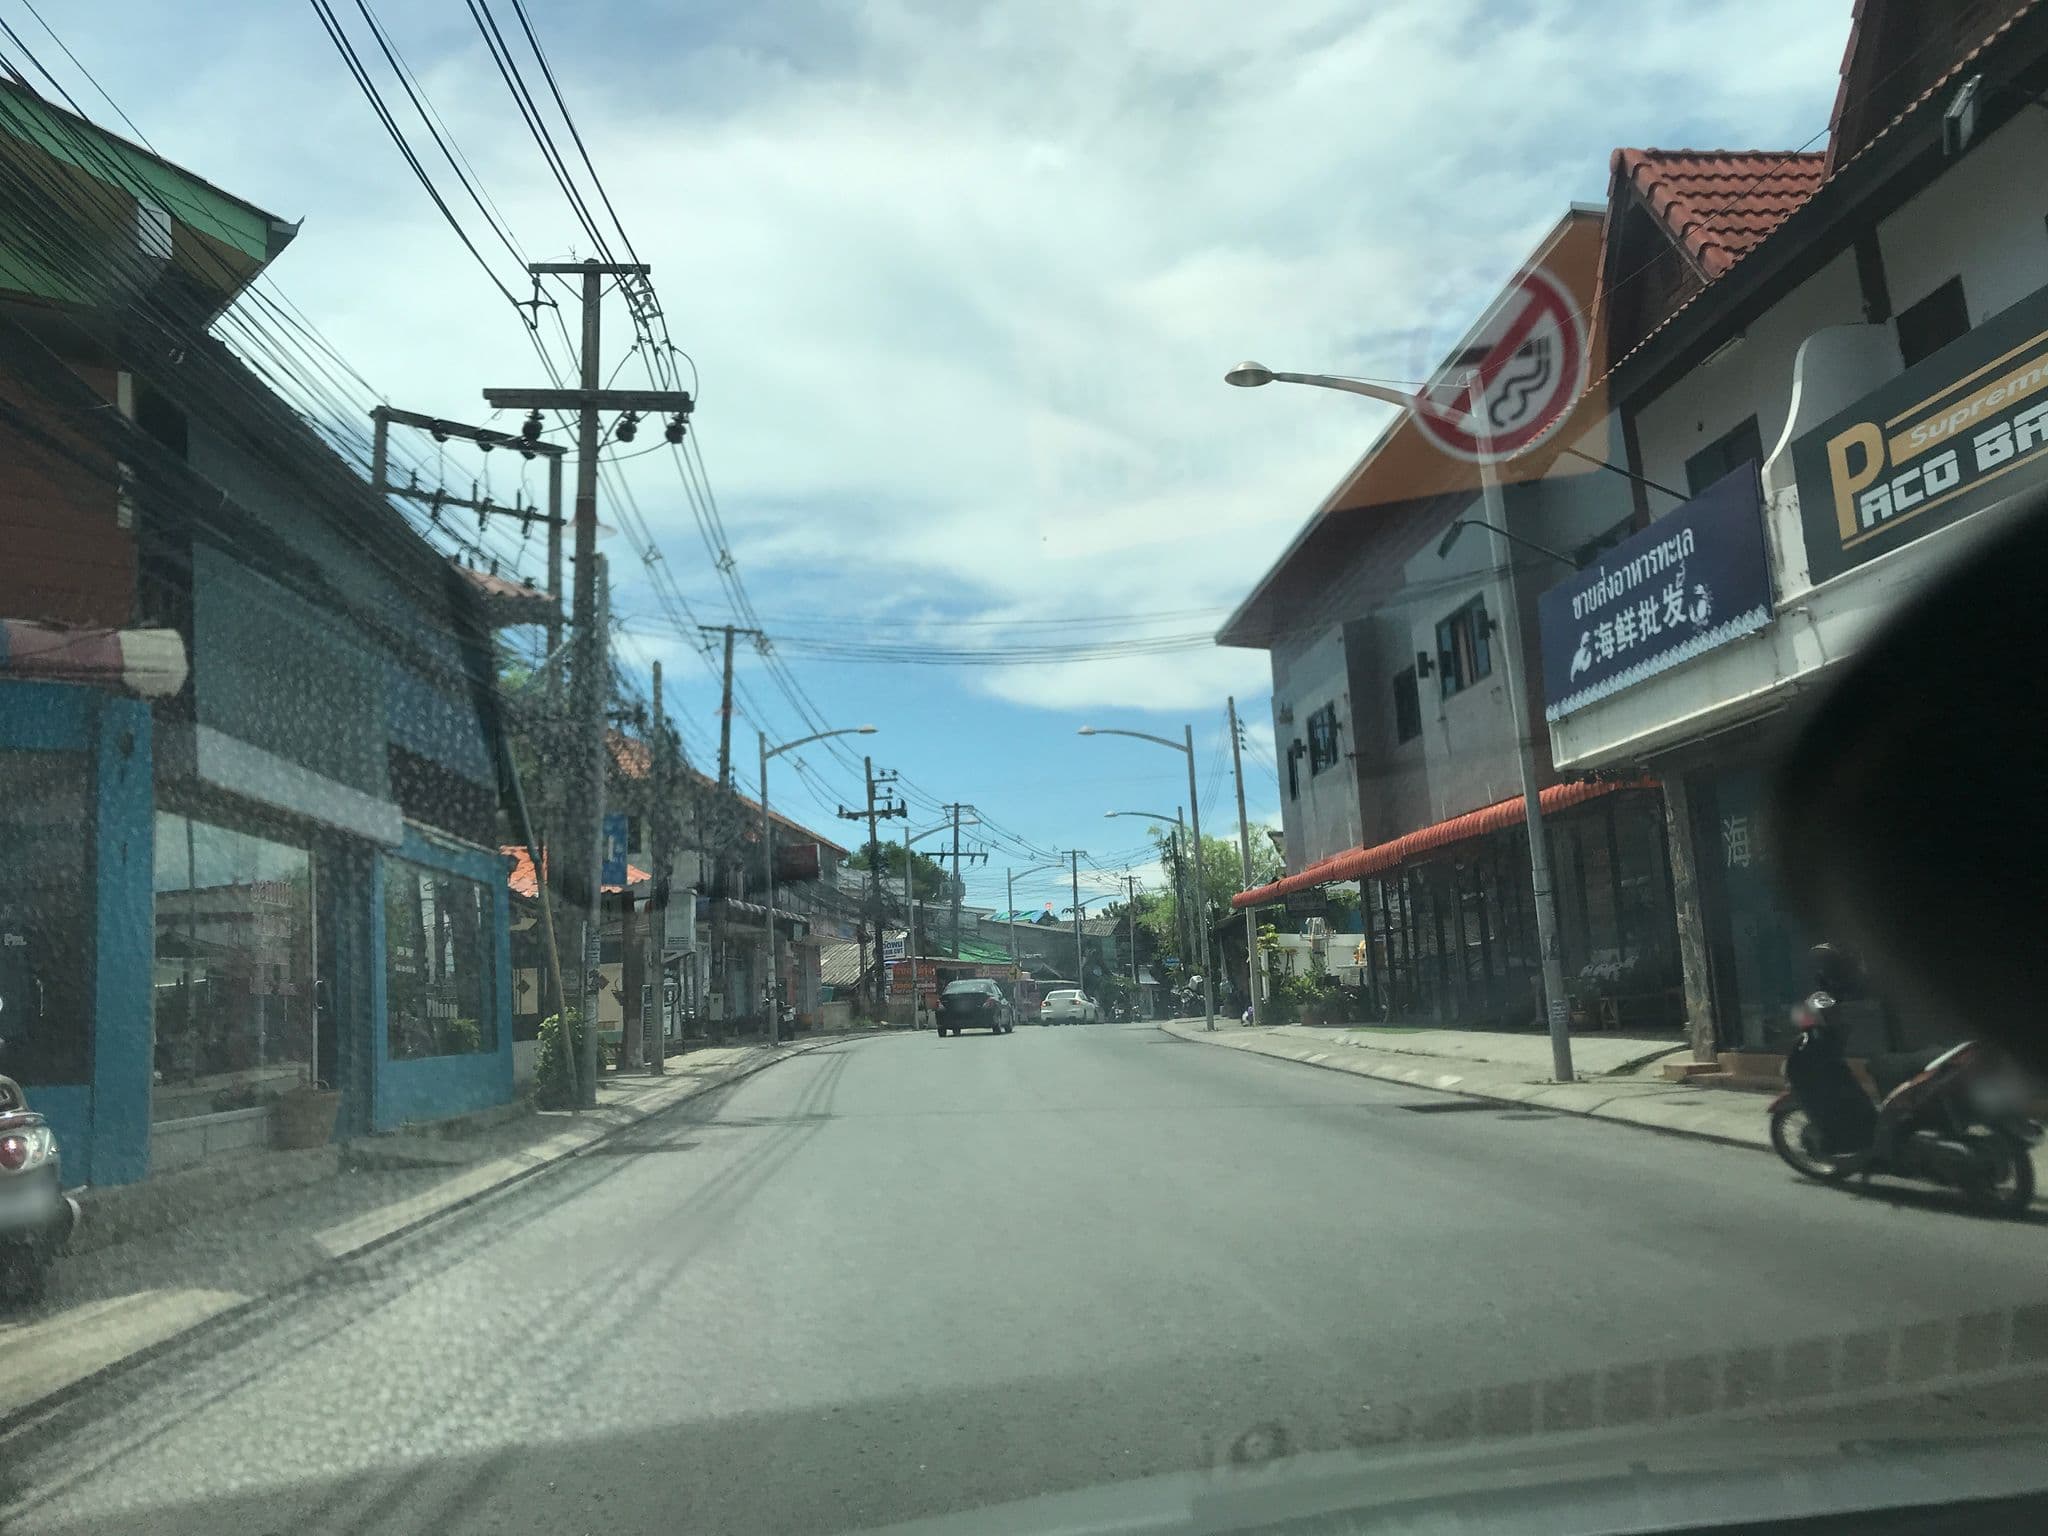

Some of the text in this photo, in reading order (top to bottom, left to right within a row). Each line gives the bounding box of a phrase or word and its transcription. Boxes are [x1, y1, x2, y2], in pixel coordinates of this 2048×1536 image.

[1826, 421, 1961, 541] PACO
[1571, 527, 1696, 620] ขายส่งอาหารทะเล
[1593, 583, 1688, 663] 海鲜批发
